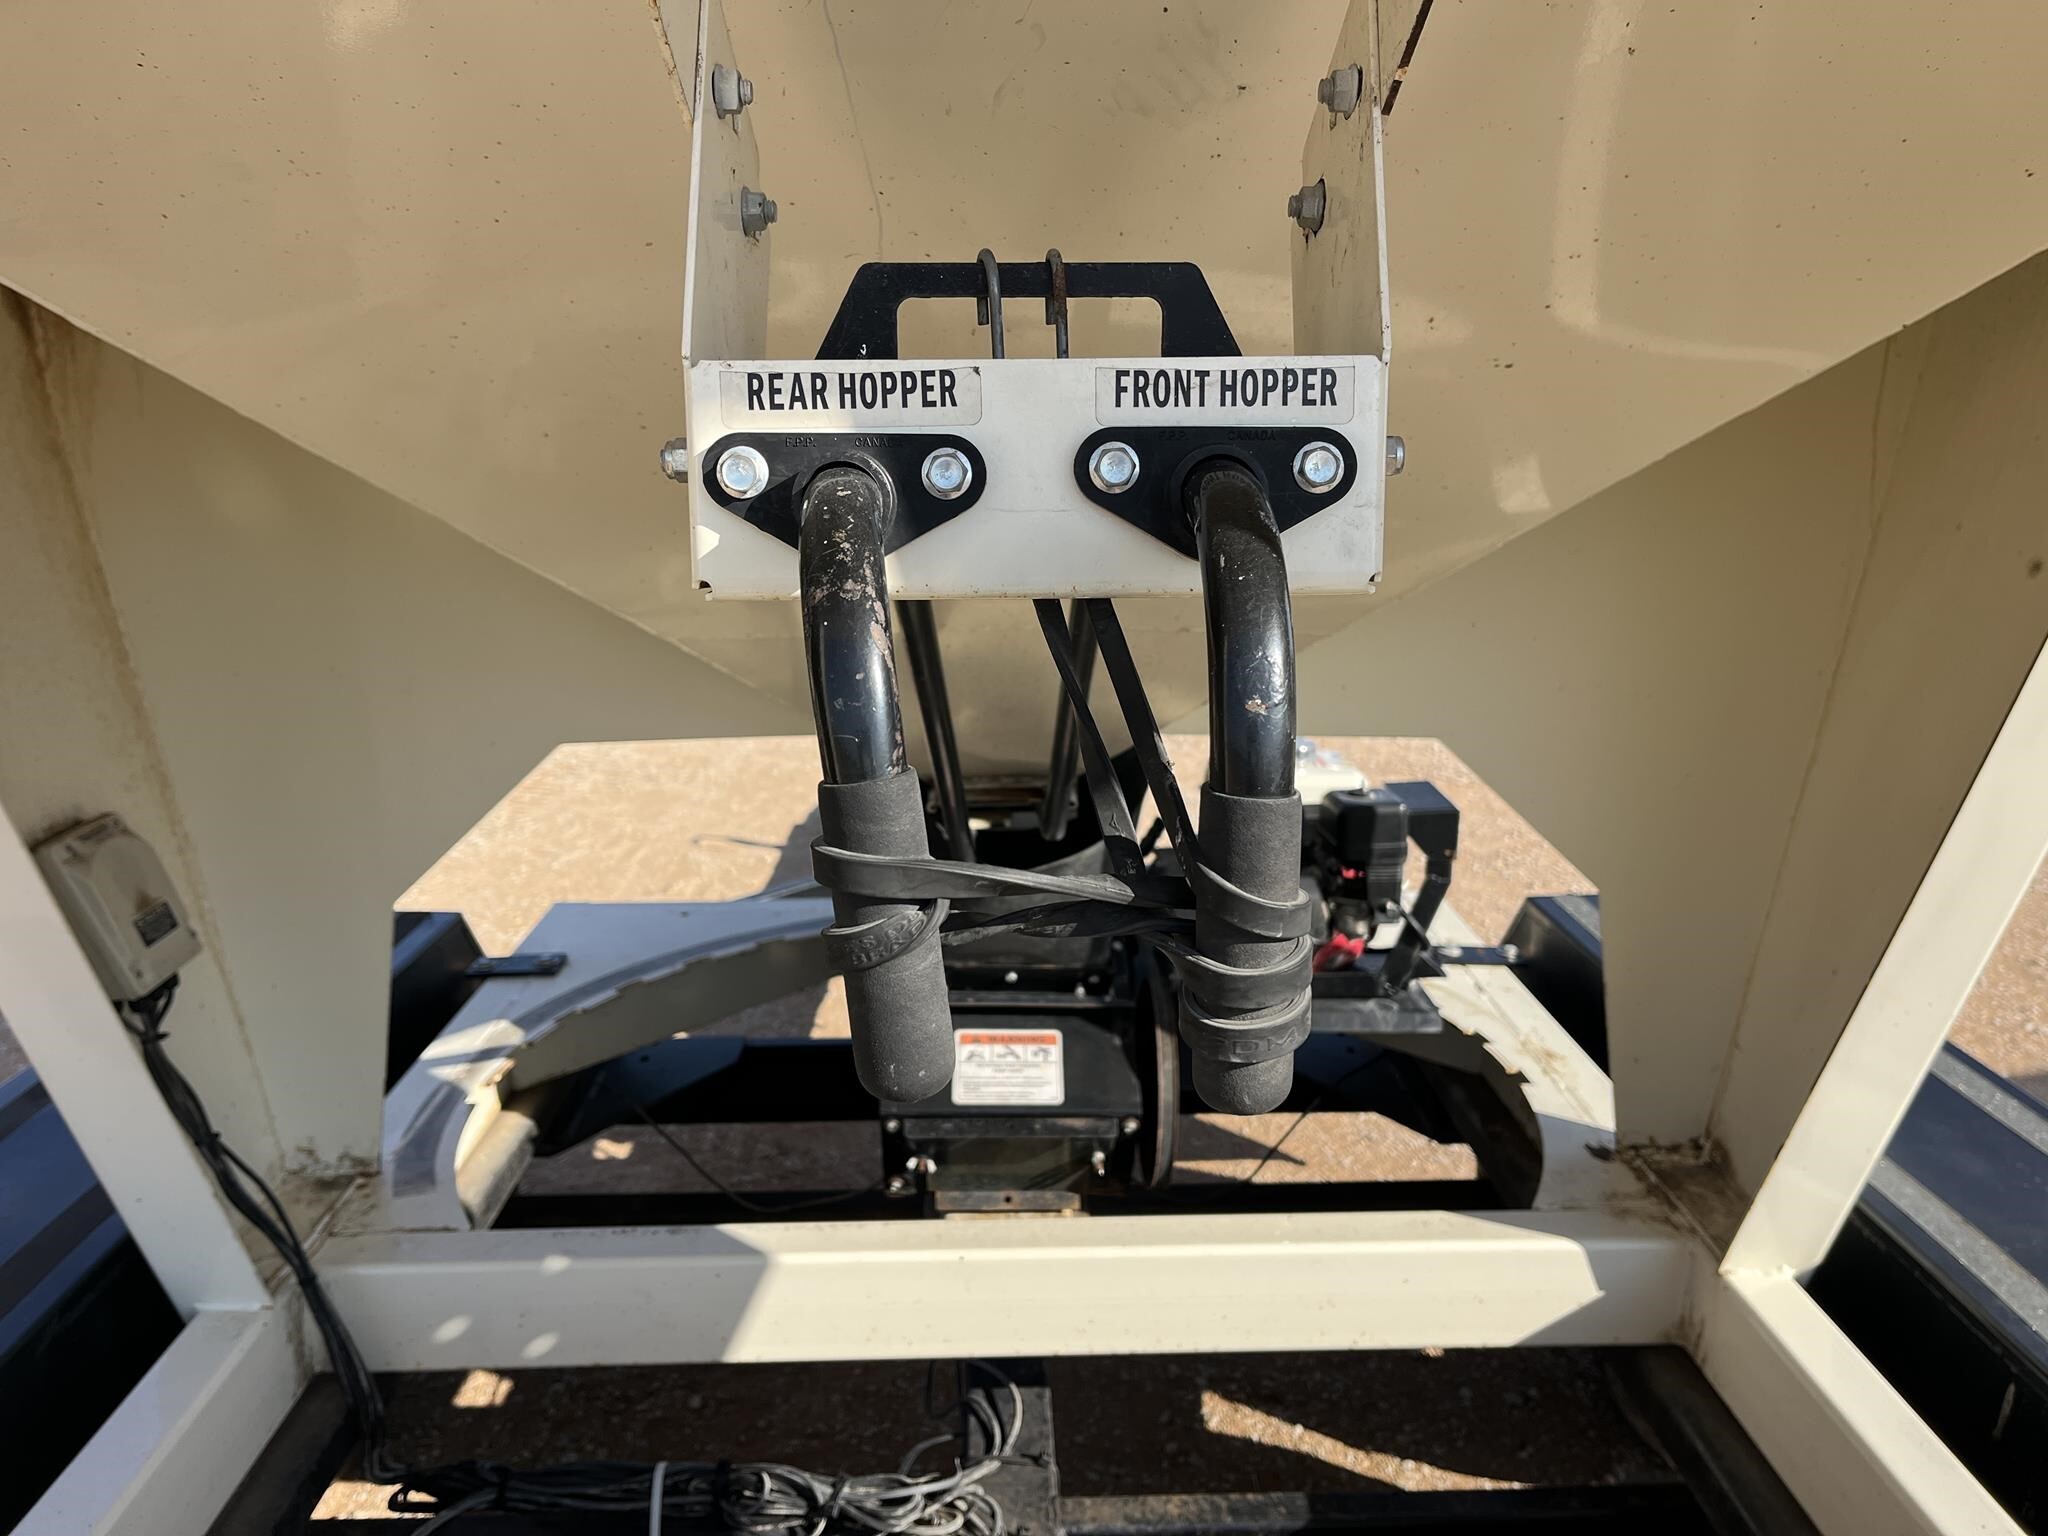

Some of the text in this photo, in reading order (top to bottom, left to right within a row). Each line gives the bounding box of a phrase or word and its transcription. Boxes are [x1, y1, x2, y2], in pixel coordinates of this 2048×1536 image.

[747, 369, 958, 411] REAR HOPPER
[1114, 367, 1338, 408] FRONT HOPPER
